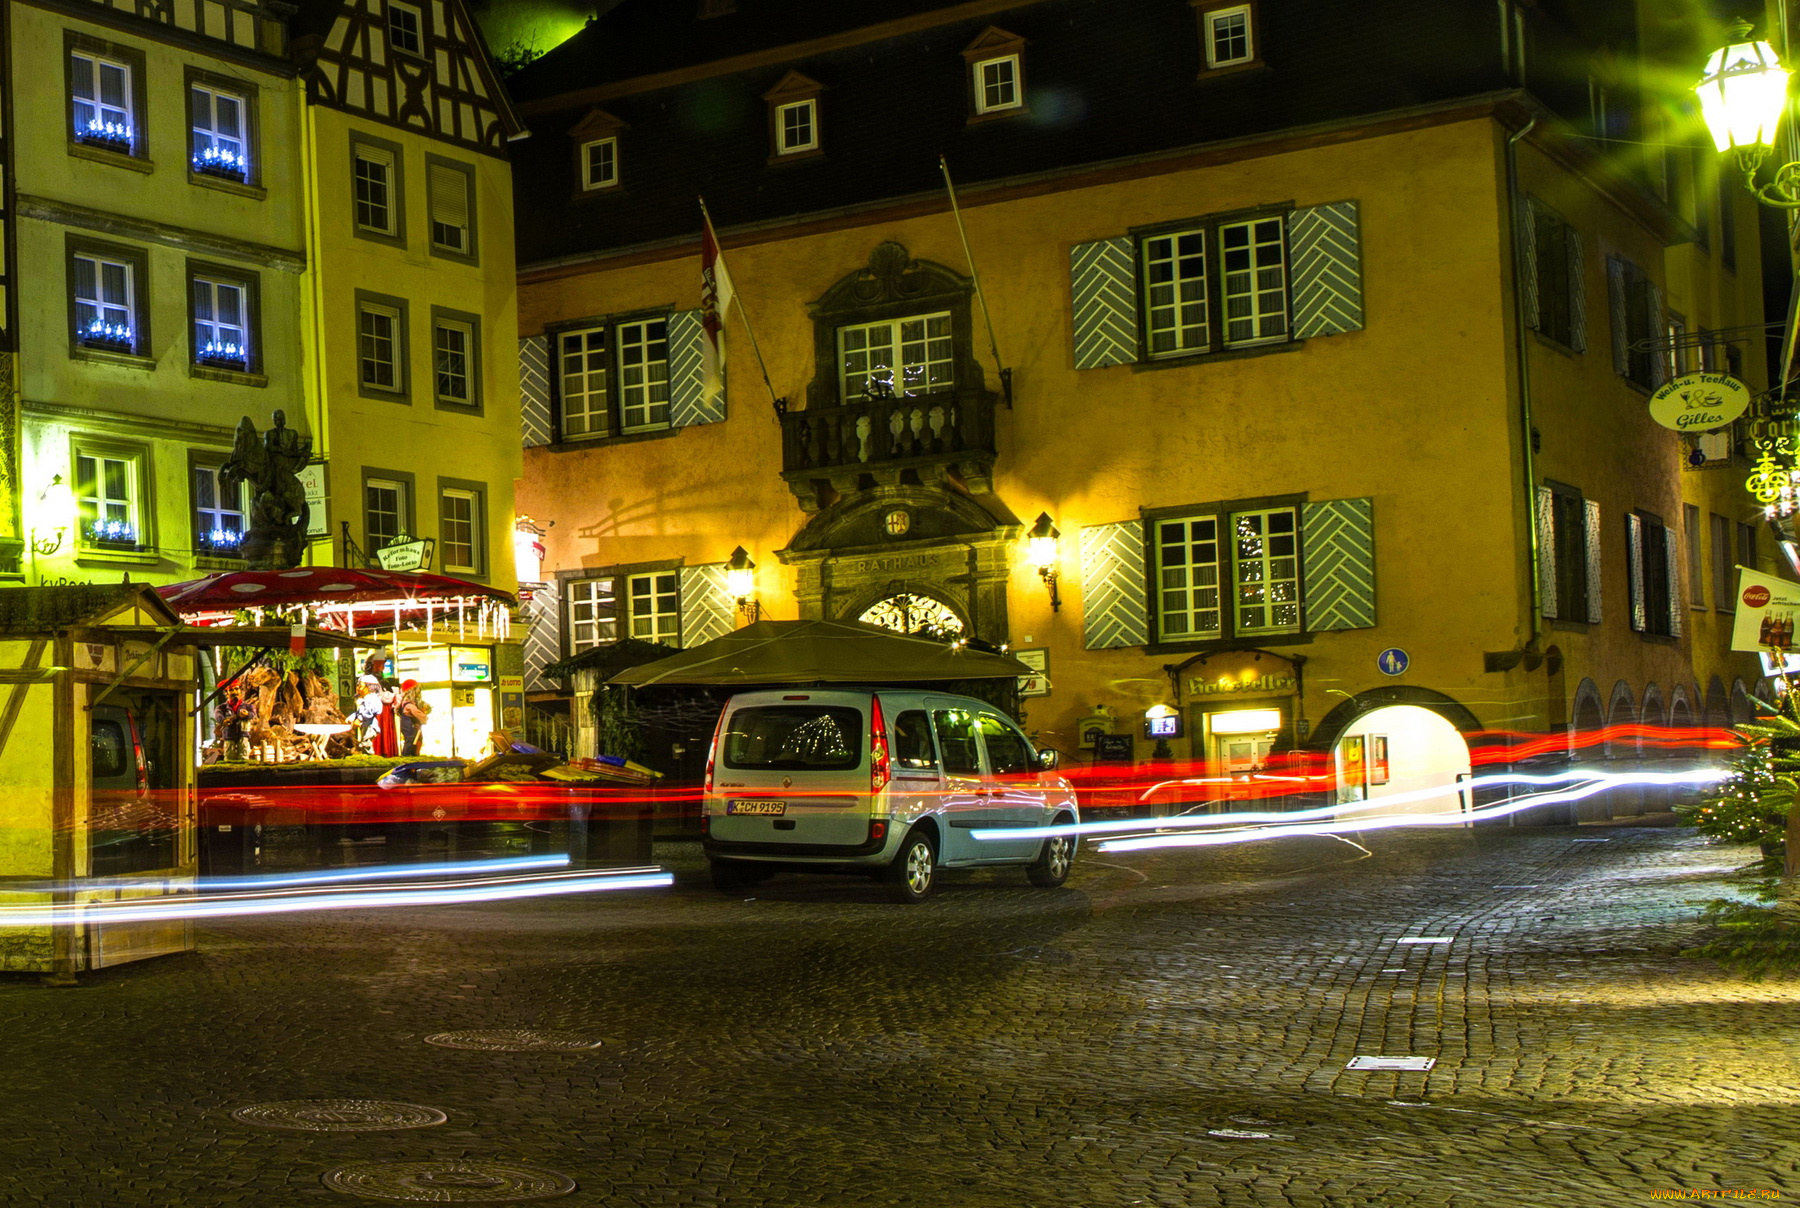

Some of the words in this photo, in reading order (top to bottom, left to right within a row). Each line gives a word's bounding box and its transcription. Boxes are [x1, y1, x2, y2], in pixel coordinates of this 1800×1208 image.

[1699, 375, 1741, 392] Teehaus
[1676, 412, 1723, 429] Gilles
[858, 554, 938, 572] RATHAUS
[745, 803, 757, 812] CH
[760, 802, 783, 812] 9195
